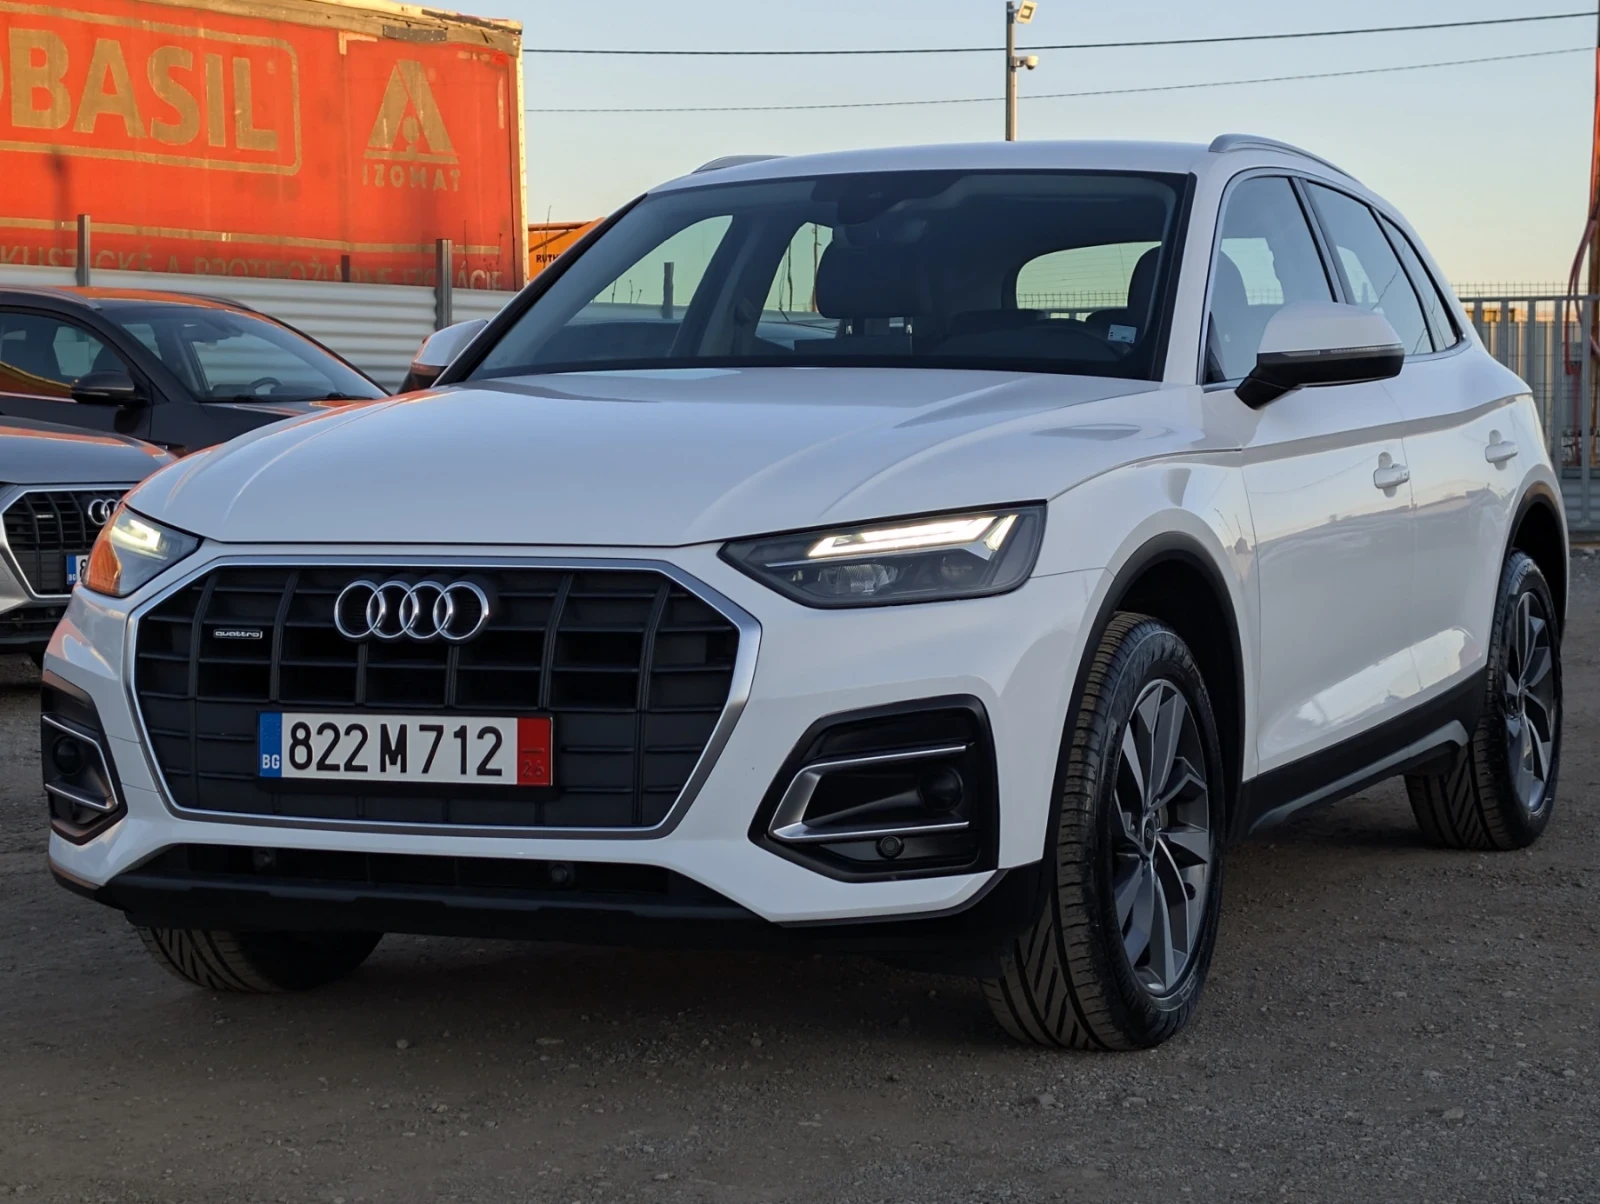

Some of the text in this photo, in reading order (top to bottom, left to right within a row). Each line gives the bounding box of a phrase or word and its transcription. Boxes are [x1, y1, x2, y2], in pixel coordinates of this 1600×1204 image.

[0, 27, 279, 151] BASIL
[362, 163, 461, 192] IZOMAT
[262, 754, 280, 769] BG
